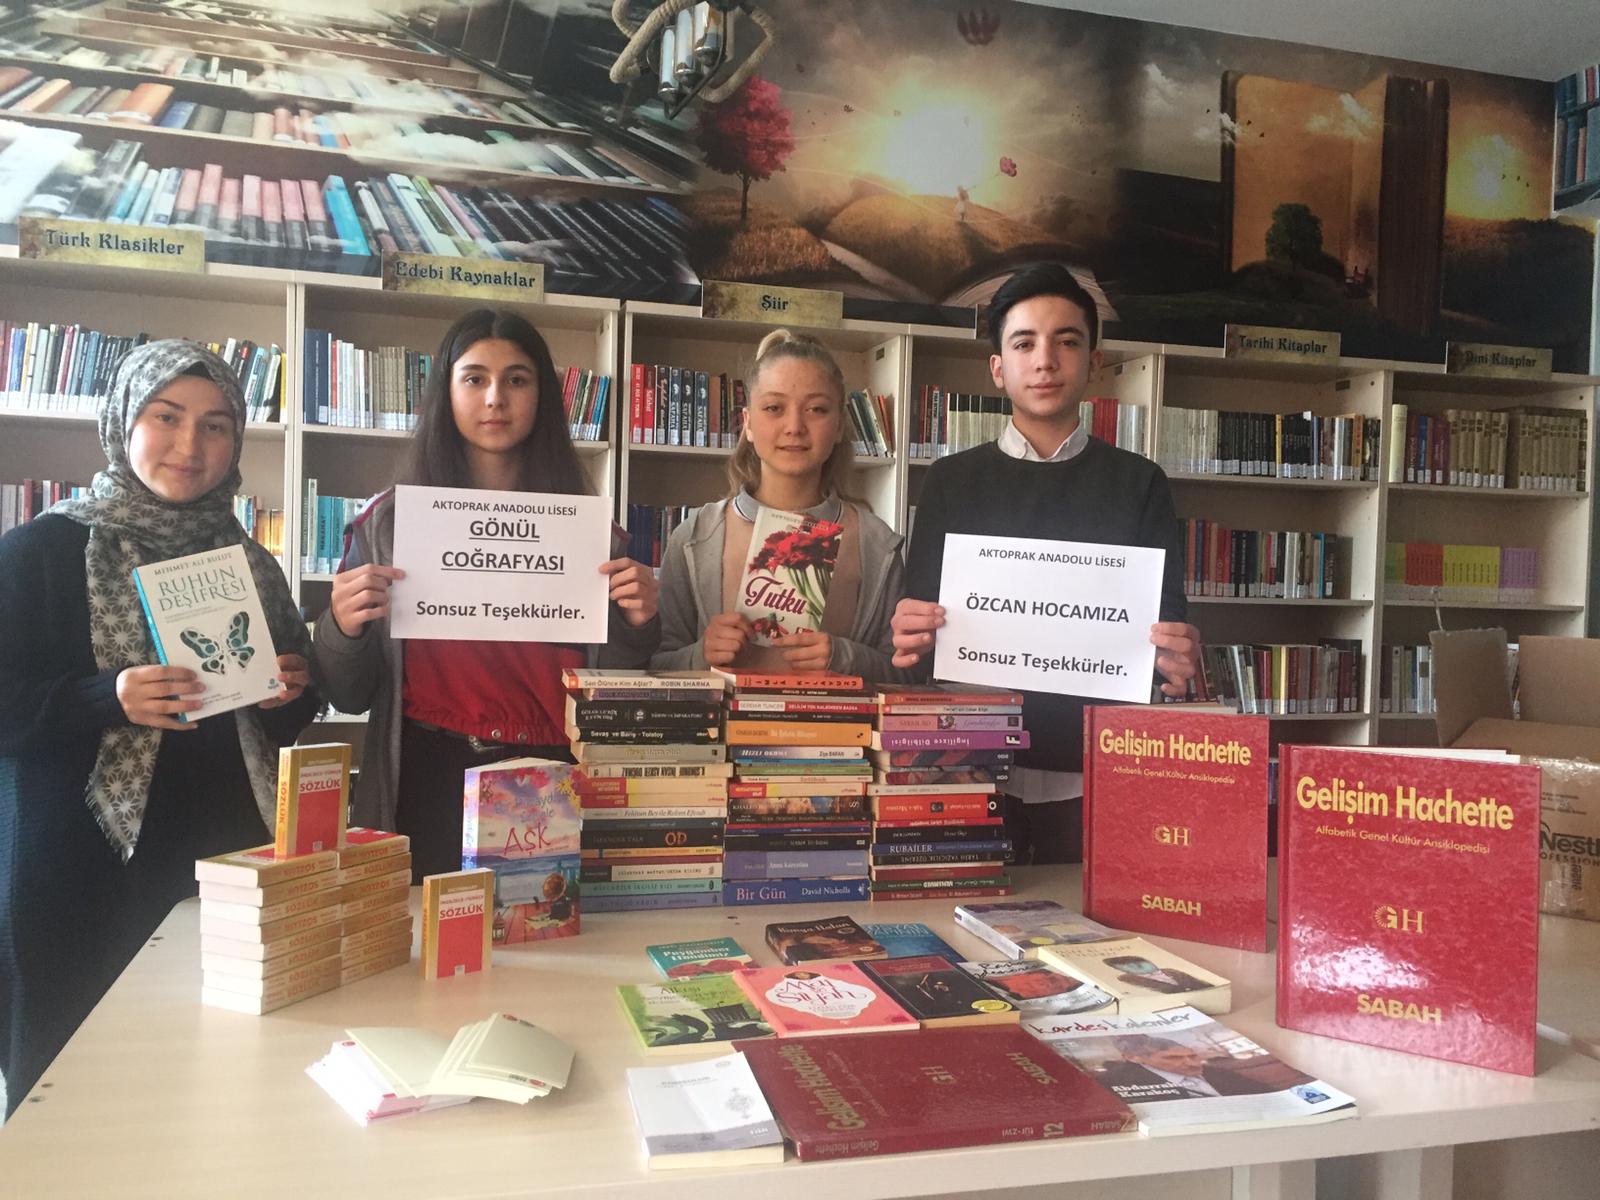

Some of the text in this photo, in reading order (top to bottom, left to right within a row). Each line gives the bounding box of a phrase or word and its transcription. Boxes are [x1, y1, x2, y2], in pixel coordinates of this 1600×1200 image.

[46, 229, 185, 255] Türk Klasikler
[395, 261, 536, 288] Edebi Kaynaklar
[761, 294, 789, 311] Şiir
[1239, 335, 1328, 354] Tarihi Kitaplar
[1491, 352, 1537, 368] Kitaplar
[432, 499, 577, 516] AKTOPRAK ANADOLU LİSESİ
[469, 518, 540, 540] GÖNÜL
[441, 548, 565, 572] COĞRAFYASI
[978, 548, 1126, 568] AKTOPRAK ANADOLU LİSESİ
[154, 564, 190, 576] MEHMET
[158, 565, 236, 597] RUHUN
[744, 576, 807, 615] Tutku
[416, 600, 585, 621] Sonsuz Teşekkürler.
[966, 592, 1129, 623] ÖZCAN HOCAMIZA
[958, 646, 1128, 676] Sonsuz Teşekkürler.
[642, 731, 664, 739] Tolstoy
[1099, 728, 1252, 766] Gelişim Hachette
[300, 778, 341, 792] SÖZLÜK
[1112, 766, 1236, 784] Alfabetik Genel Kültür Ansiklopedisi
[279, 781, 288, 824] SÖZLÜK
[1296, 776, 1514, 830] Gelişim Hachette
[503, 822, 552, 857] AŞK
[1153, 825, 1192, 847] GH
[1315, 825, 1491, 855] Alfabetik Genel Kültür Ansiklopedisi
[889, 844, 933, 854] RUBAİLER
[735, 885, 851, 901] Bir Gün David Nicholls
[440, 903, 483, 919] SÖZLÜK
[1141, 894, 1202, 917] SABAH
[1374, 904, 1424, 934] GH
[1357, 993, 1442, 1025] SABAH
[1006, 1052, 1058, 1086] SABAH
[1043, 1121, 1065, 1138] 12
[1090, 1120, 1122, 1131] SABAH
[850, 1138, 880, 1151] Gelişim
